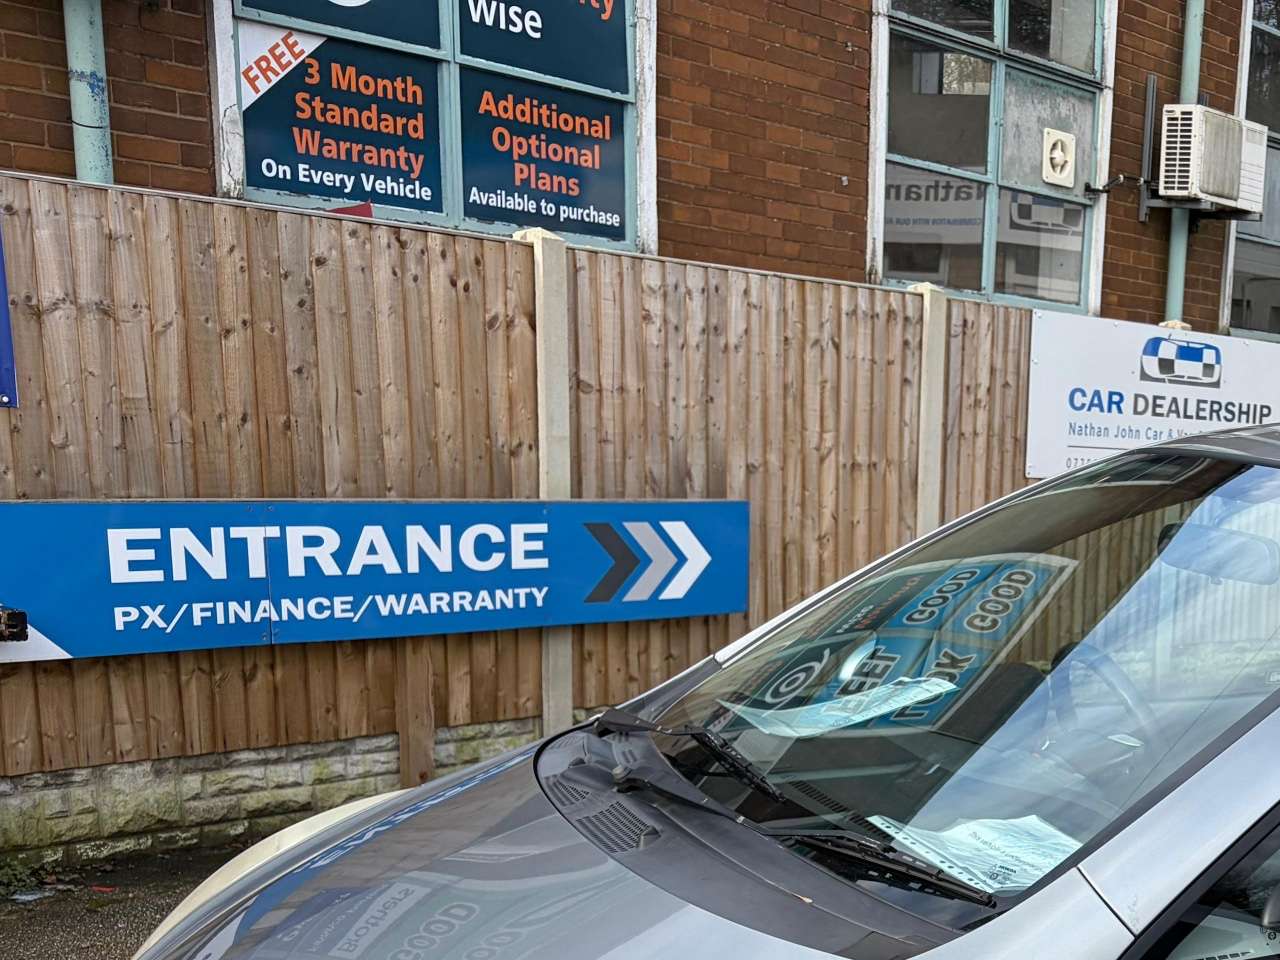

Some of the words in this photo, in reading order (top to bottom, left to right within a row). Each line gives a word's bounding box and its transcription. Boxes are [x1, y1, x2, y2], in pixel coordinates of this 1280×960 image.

[241, 32, 305, 94] FREE
[304, 58, 320, 85] 3
[331, 63, 423, 105] Month
[295, 92, 424, 140] Standard
[478, 90, 611, 140] Additional
[292, 127, 424, 179] Warranty
[491, 127, 600, 169] Optional
[261, 158, 291, 179] On
[299, 163, 355, 192] Every
[361, 173, 432, 201] Vehicle
[514, 162, 580, 196] Plans
[469, 186, 536, 213] Available
[540, 198, 555, 216] to
[559, 204, 621, 226] purchase
[1068, 387, 1125, 414] CAR
[1133, 394, 1272, 425] DEALERSHIP
[1068, 422, 1109, 437] Nathan
[1114, 424, 1140, 440] John
[1145, 427, 1163, 440] Car
[106, 522, 550, 584] ENTRANCE
[114, 586, 550, 633] PX/FINANCE/WARRANTY
